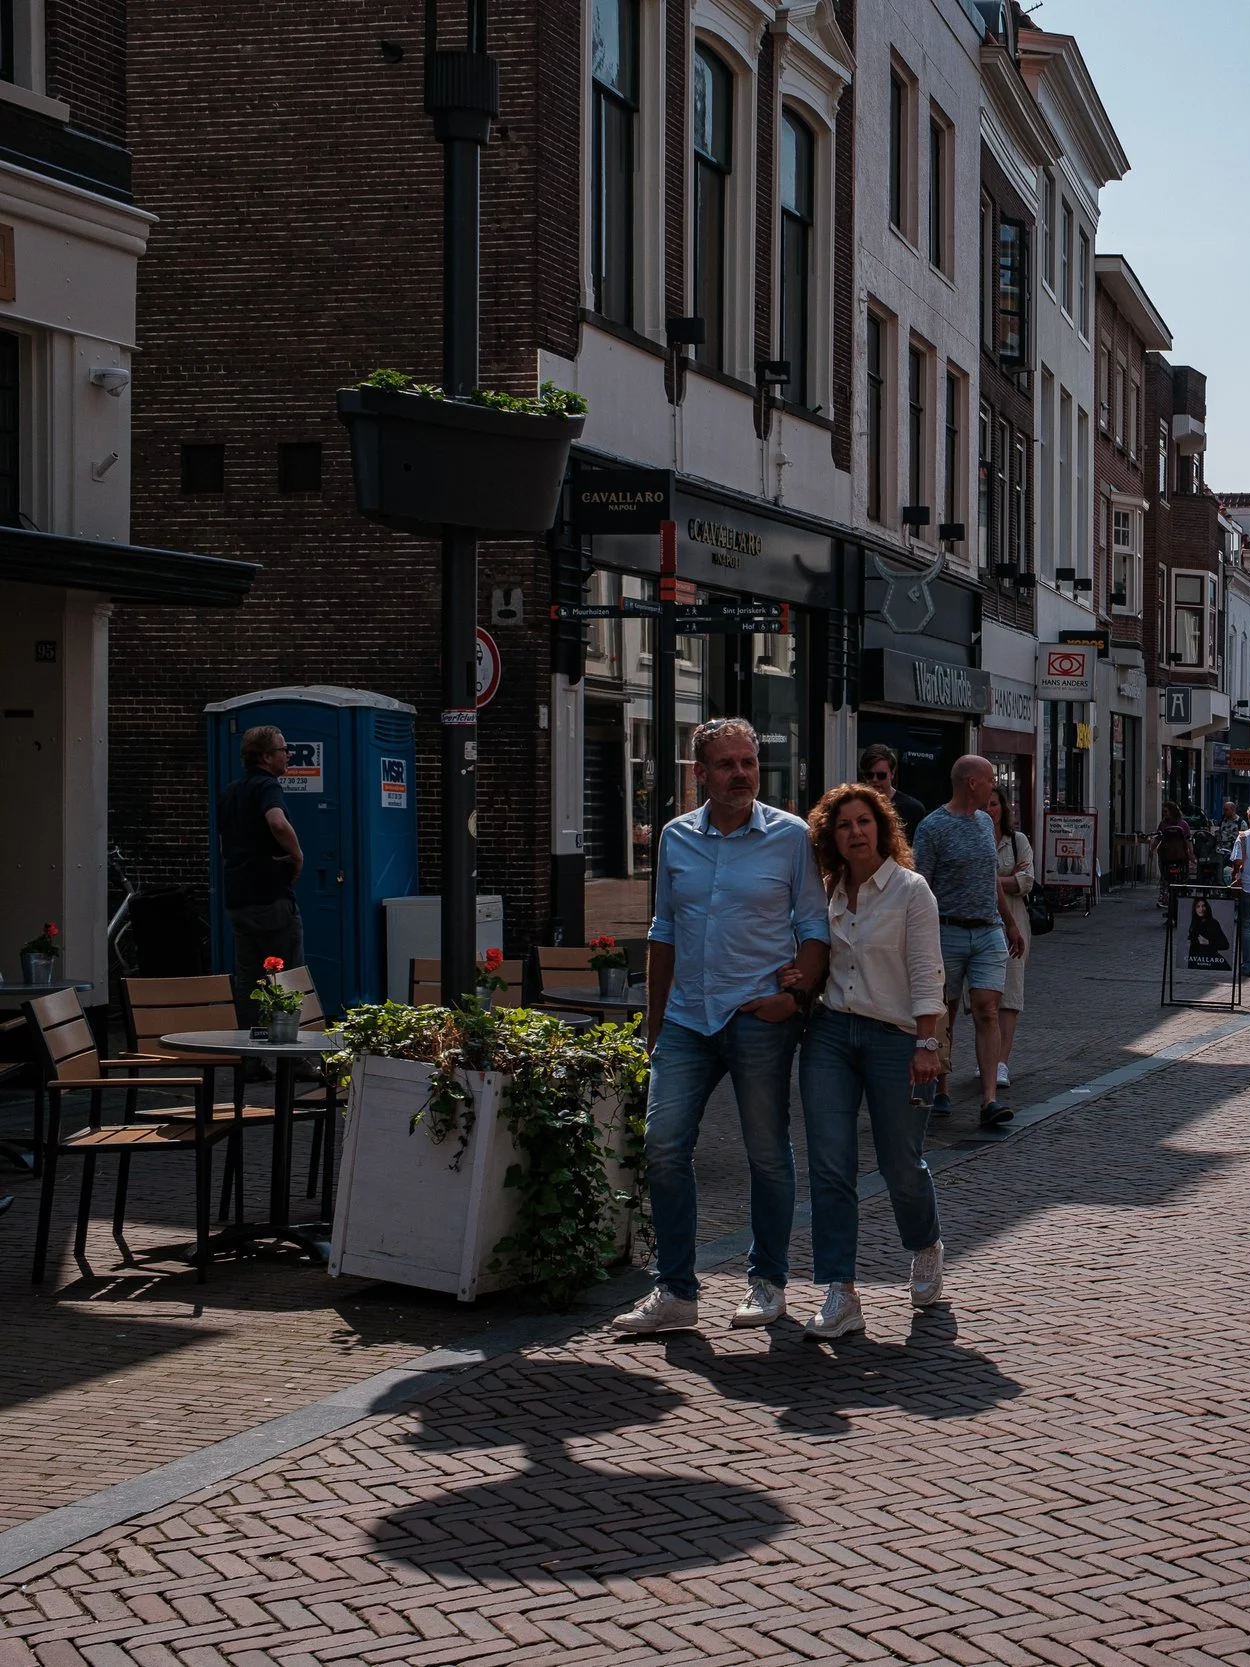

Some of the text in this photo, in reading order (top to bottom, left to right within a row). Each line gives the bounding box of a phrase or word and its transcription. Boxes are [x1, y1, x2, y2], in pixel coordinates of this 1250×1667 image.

[581, 491, 664, 503] CAVALLARO
[693, 518, 763, 556] CAVALLARO
[572, 608, 610, 616] Muurhuizen
[723, 607, 767, 616] Sint Joriskerk
[742, 623, 756, 631] Hof
[38, 644, 55, 659] 95
[995, 688, 1031, 721] HANS ANDERS
[382, 759, 404, 783] MSR
[1184, 955, 1225, 963] CAVALLARO
